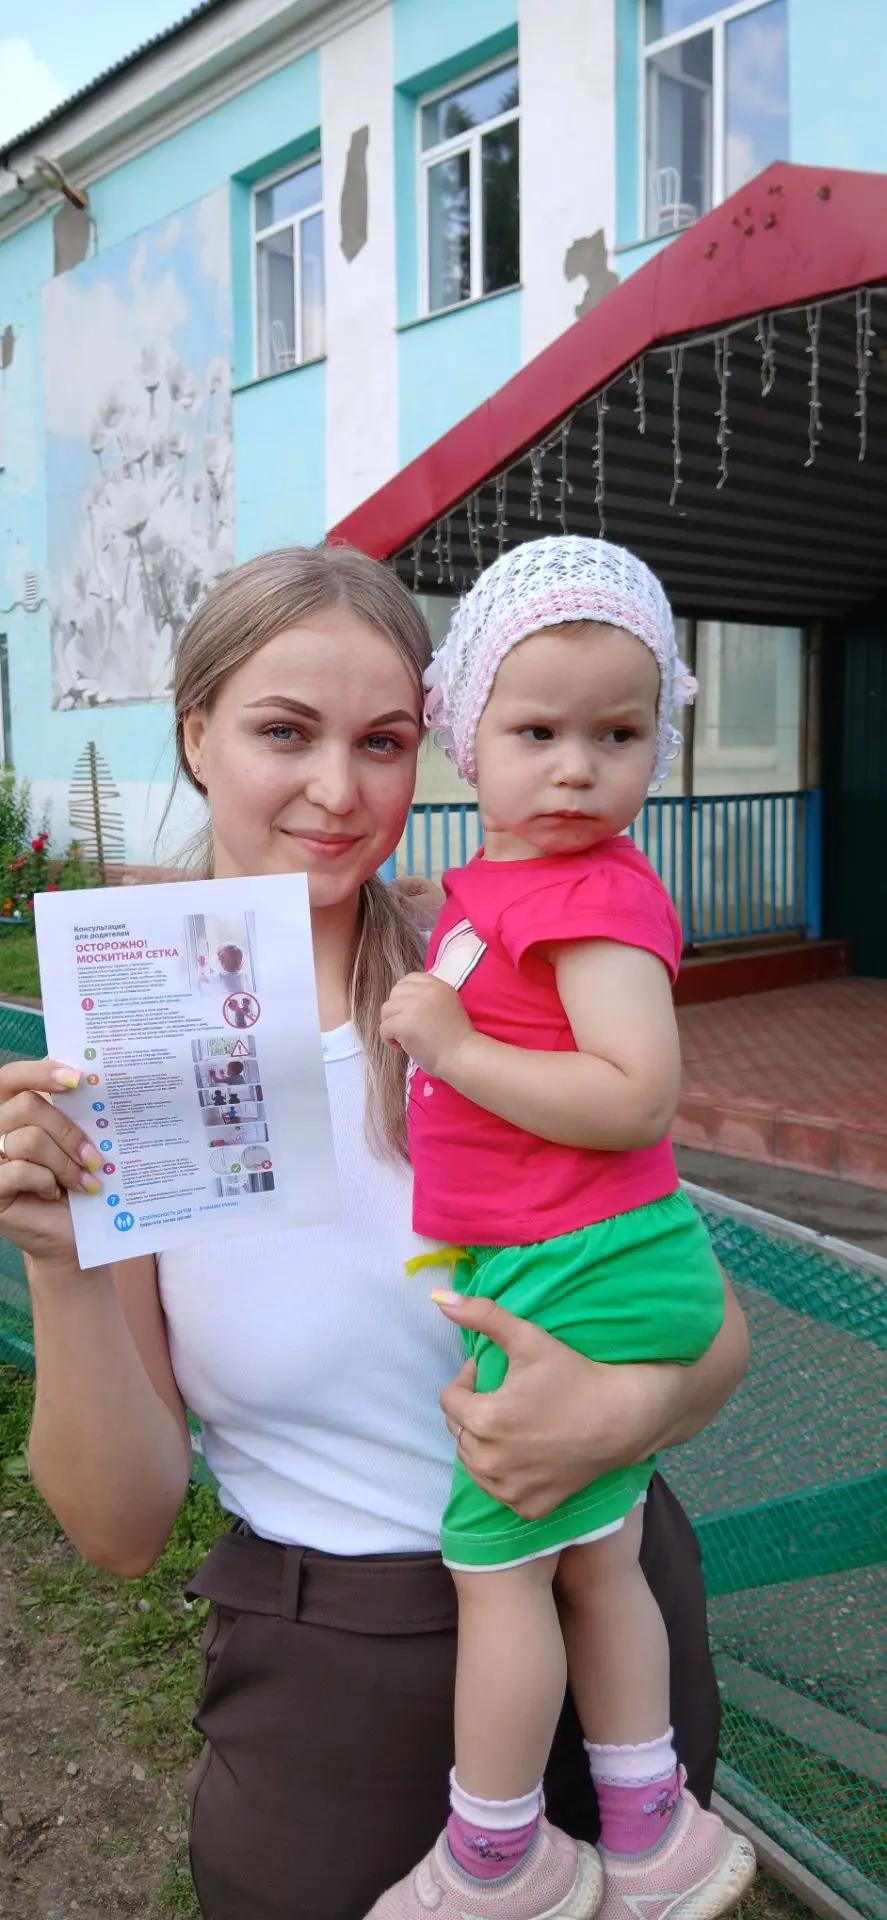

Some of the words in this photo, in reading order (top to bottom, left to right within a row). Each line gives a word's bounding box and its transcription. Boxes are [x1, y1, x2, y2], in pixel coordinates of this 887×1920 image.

[73, 923, 126, 933] Консультация
[74, 933, 89, 941] для
[89, 930, 130, 940] родителей
[75, 939, 148, 953] ОСТОРОЖНО!
[76, 950, 143, 964] МОСКИТНАЯ
[145, 948, 179, 959] СЕТКА
